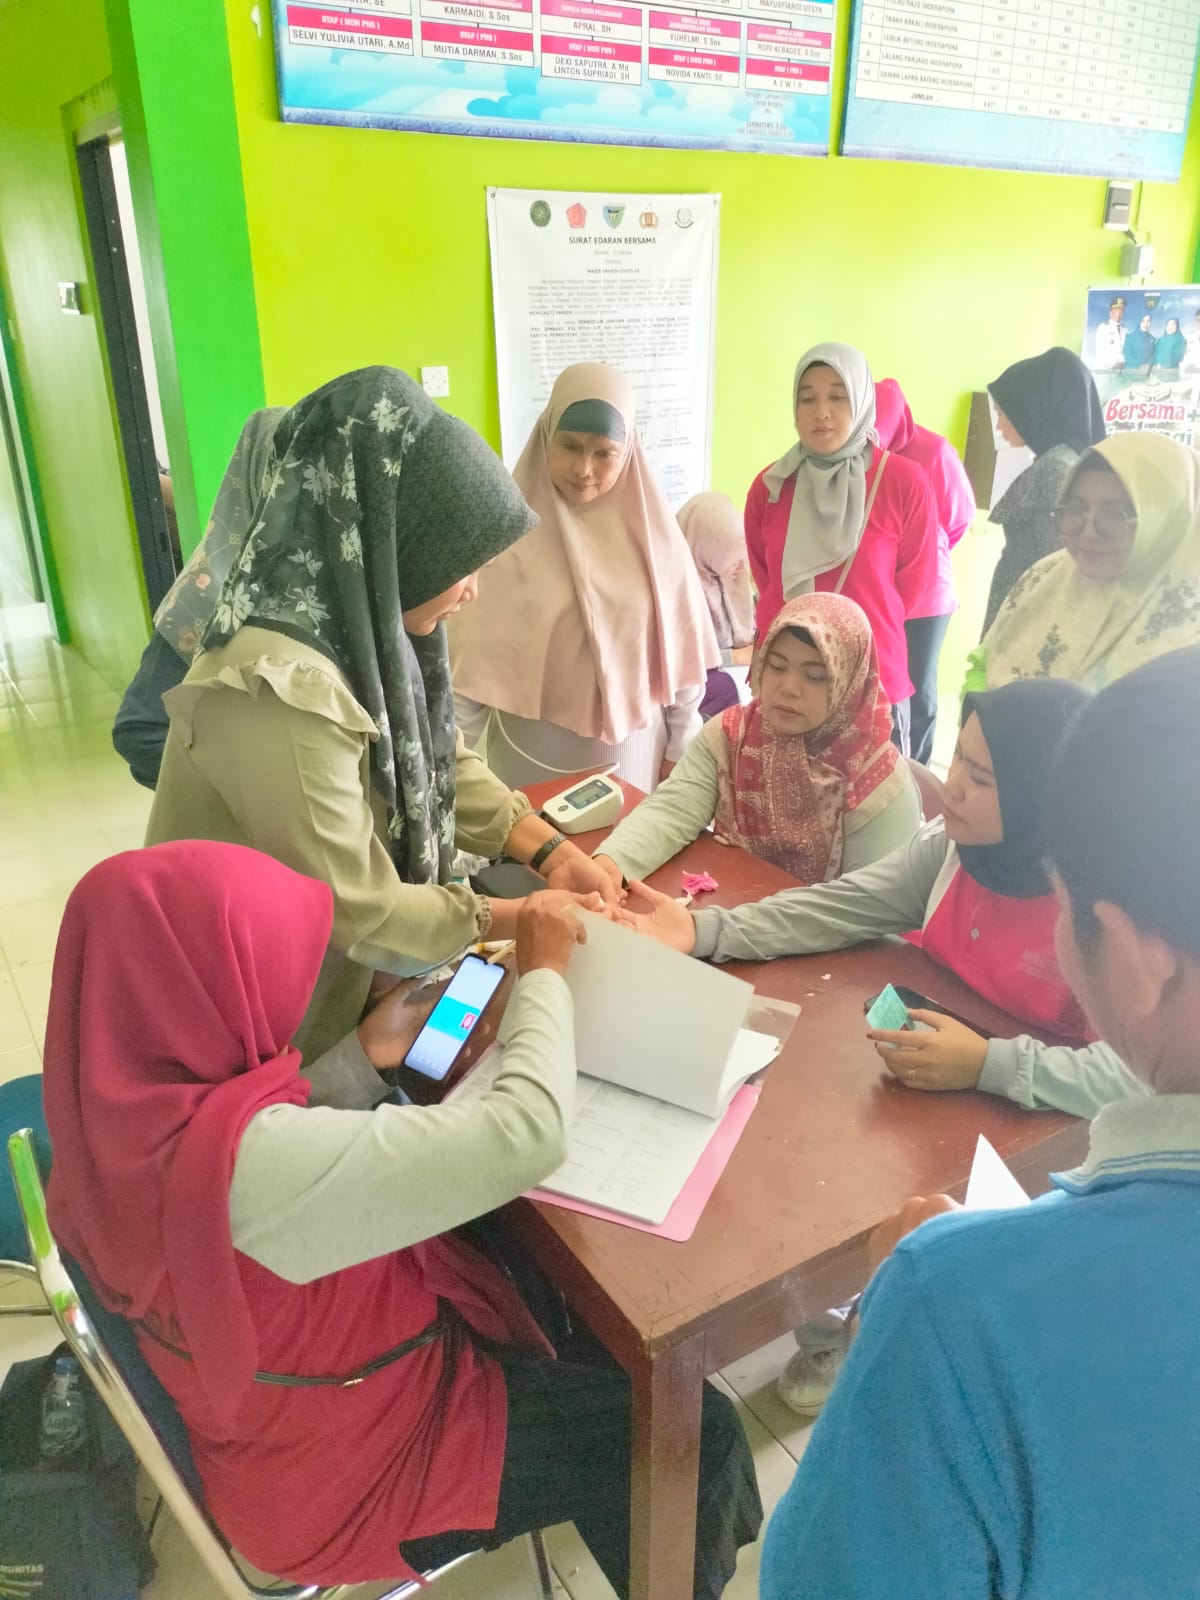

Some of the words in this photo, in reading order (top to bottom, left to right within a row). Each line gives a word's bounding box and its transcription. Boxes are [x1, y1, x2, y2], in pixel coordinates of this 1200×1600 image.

[292, 30, 317, 40] SELVI
[320, 33, 355, 44] YULIVIA
[388, 40, 409, 50] A.Md
[434, 44, 460, 55] MUTIA
[666, 68, 690, 78] NOVIDA
[569, 236, 592, 244] SURAT
[624, 237, 656, 245] BERSAMA
[1106, 398, 1185, 422] Bersama
